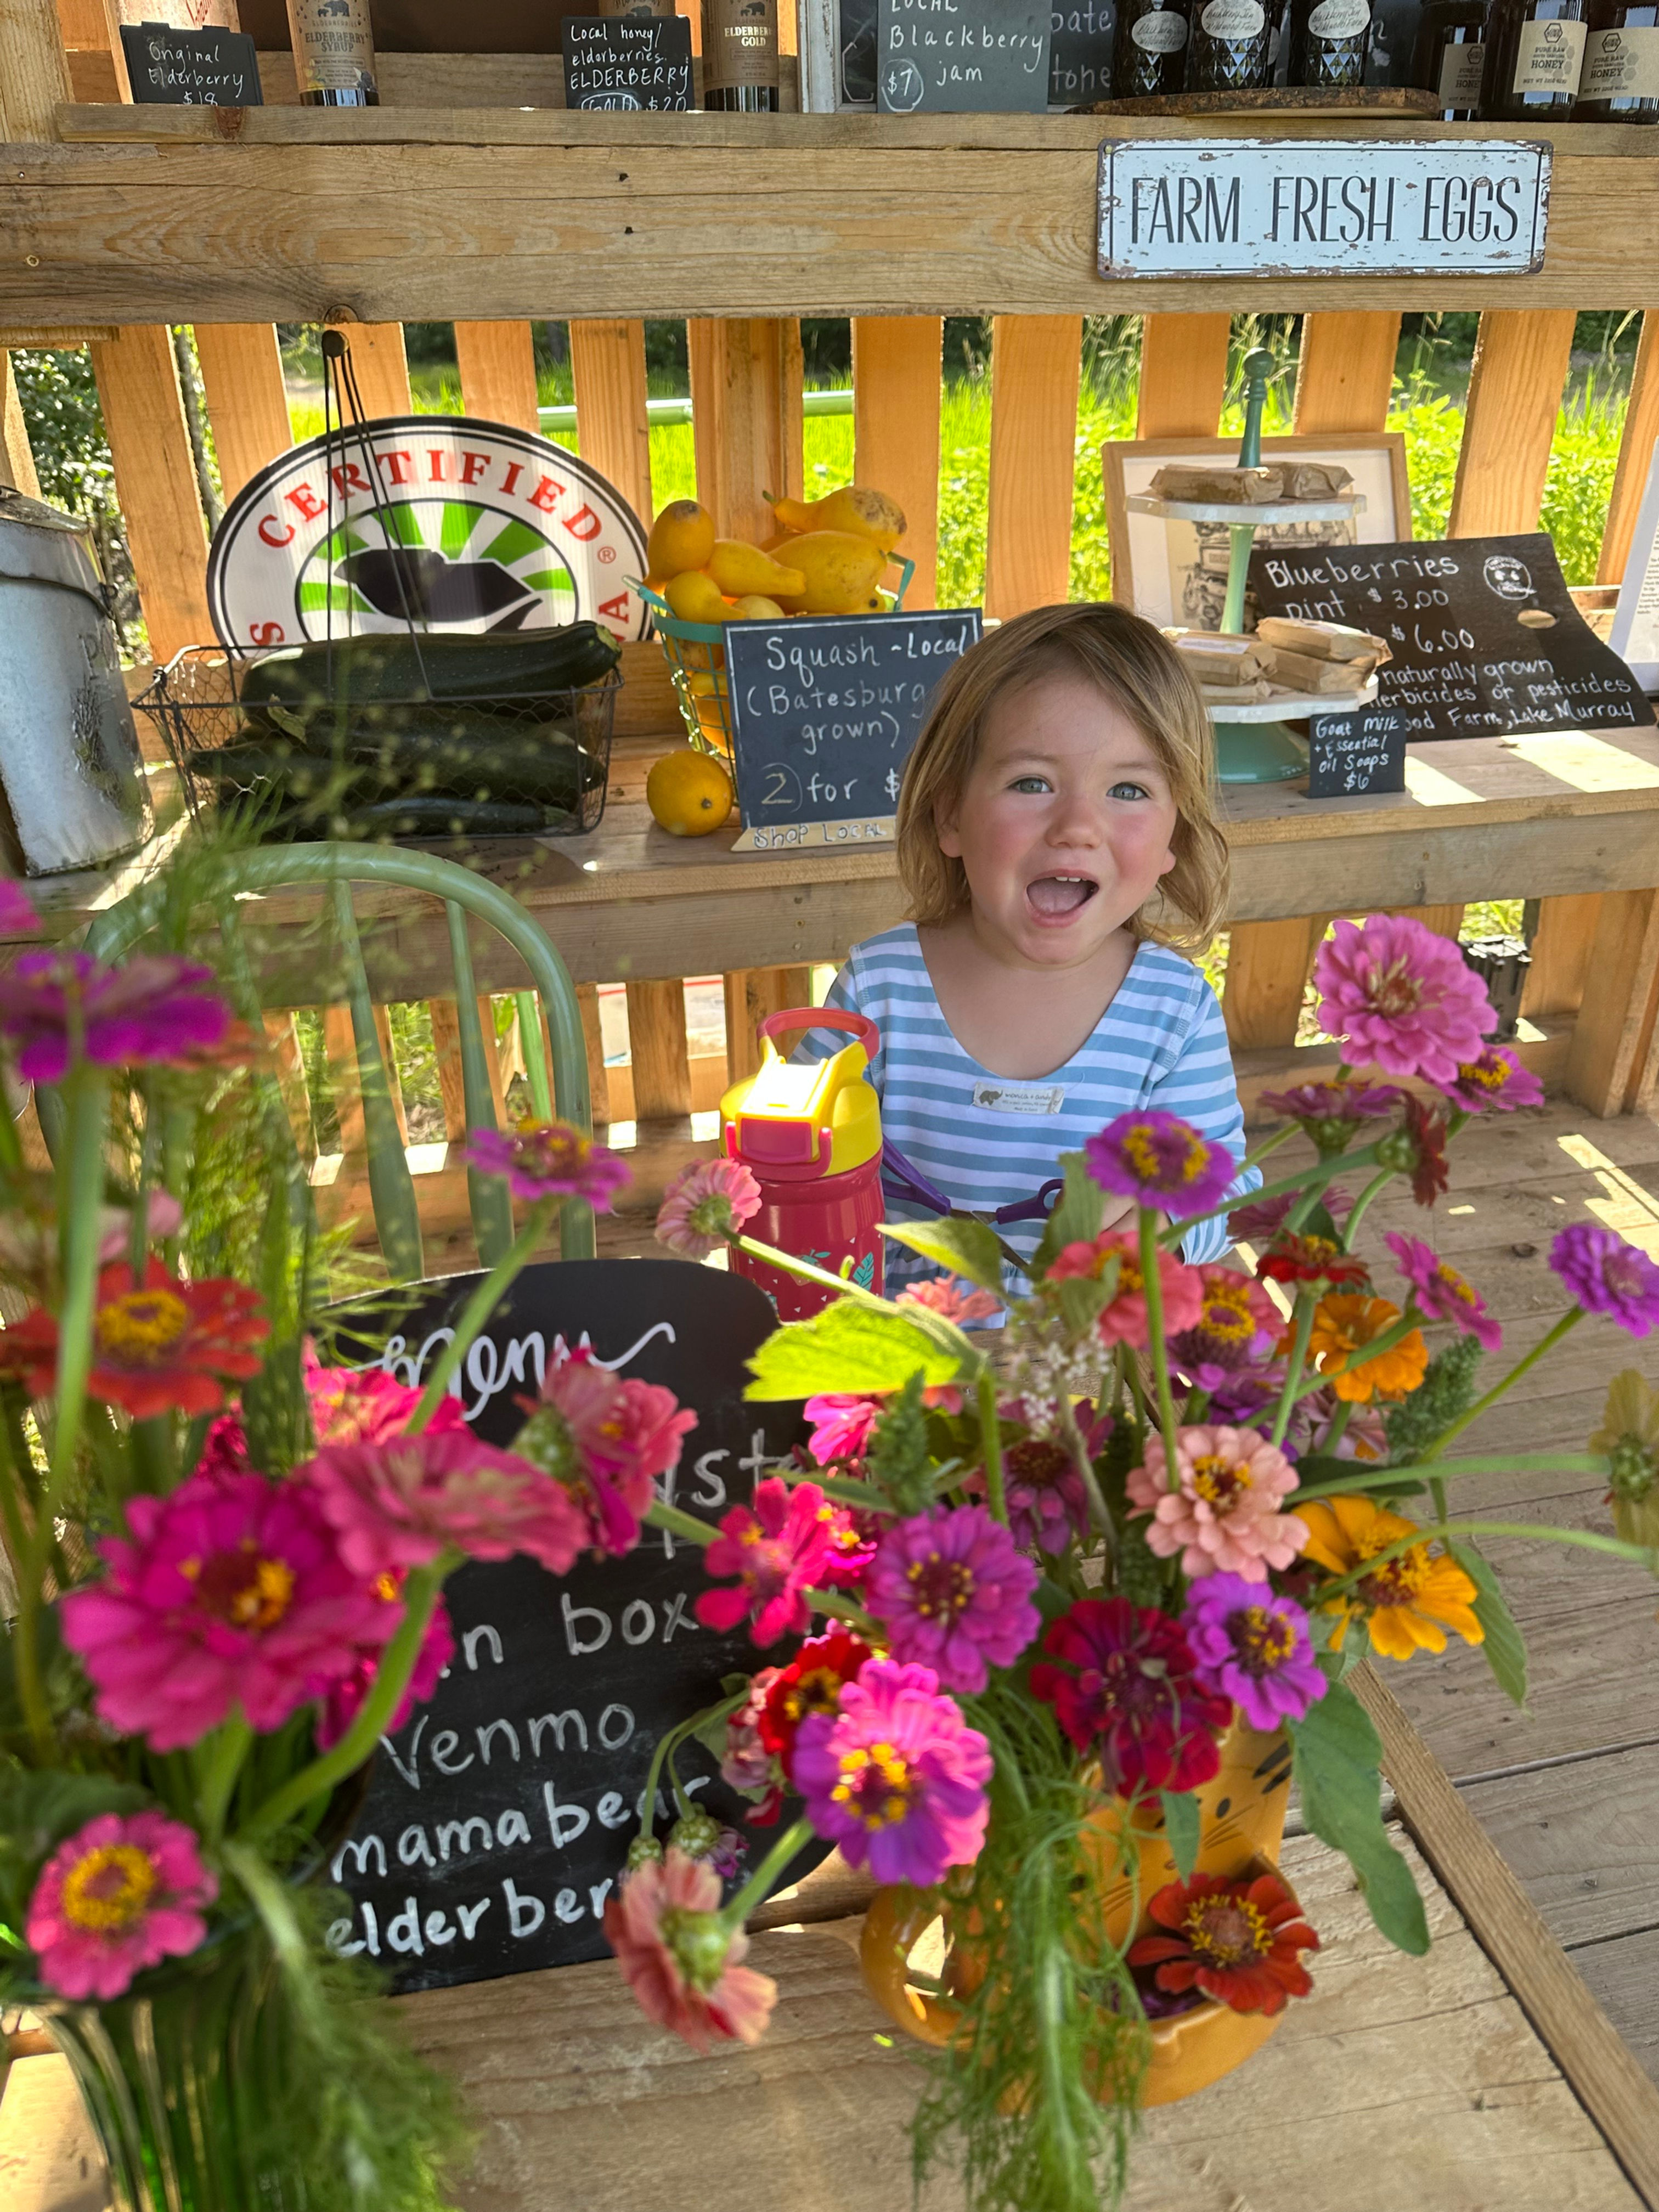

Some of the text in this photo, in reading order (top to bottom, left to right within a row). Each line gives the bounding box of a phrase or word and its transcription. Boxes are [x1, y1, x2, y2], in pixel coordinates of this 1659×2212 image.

[305, 31, 365, 44] ELDERBERRY
[571, 23, 608, 42] Local
[741, 36, 766, 47] GOLD
[149, 41, 219, 76] Original
[321, 41, 354, 53] SYRUP
[890, 25, 1043, 72] Blackberry
[936, 61, 983, 86] jam
[1531, 59, 1564, 69] HONEY
[1590, 67, 1624, 79] HONEY
[148, 67, 243, 98] Elderberry
[183, 92, 218, 106] $18
[1131, 175, 1520, 244] FARM FRESH EGGS
[257, 449, 602, 548] CERTIFIED
[1265, 555, 1460, 588] Blueberries
[766, 636, 880, 688] Squash
[1381, 659, 1555, 687] naturally grown
[1492, 686, 1515, 700] or
[1527, 677, 1632, 704] pesticides
[1555, 699, 1636, 723] Murray
[801, 711, 900, 755] grown)
[1316, 715, 1352, 738] Goat
[1344, 753, 1390, 774] Soaps
[806, 773, 859, 803] for
[1343, 771, 1369, 791] $6
[560, 1592, 699, 1656] box
[380, 1702, 635, 1790] Venmo
[325, 1877, 613, 1957] elderber
